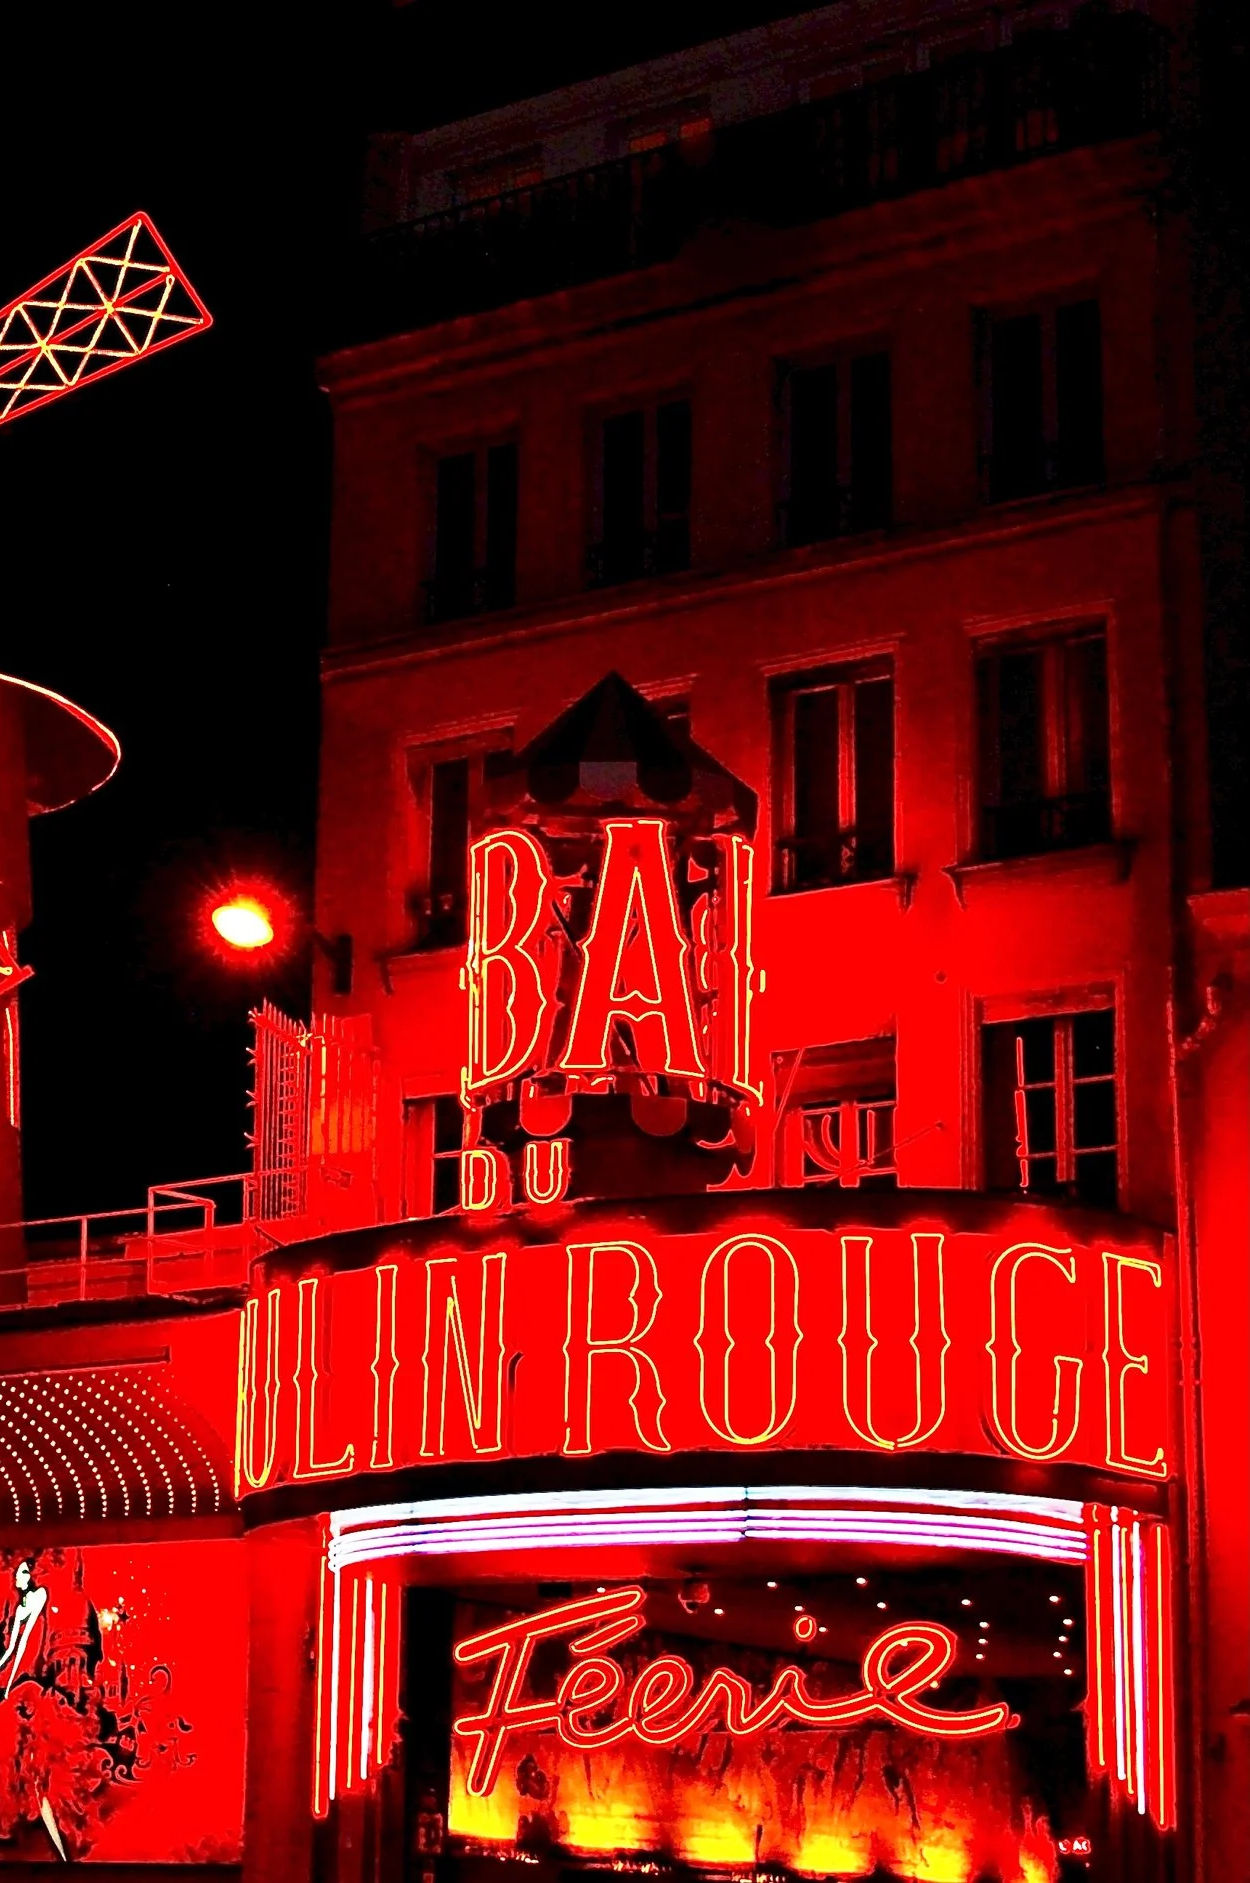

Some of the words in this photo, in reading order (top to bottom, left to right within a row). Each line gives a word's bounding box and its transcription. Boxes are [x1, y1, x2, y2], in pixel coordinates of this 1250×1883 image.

[461, 1141, 564, 1209] DU
[234, 1251, 507, 1498] ULIN
[562, 1232, 1167, 1477] ROUGE
[454, 1585, 1009, 1797] Féerie
